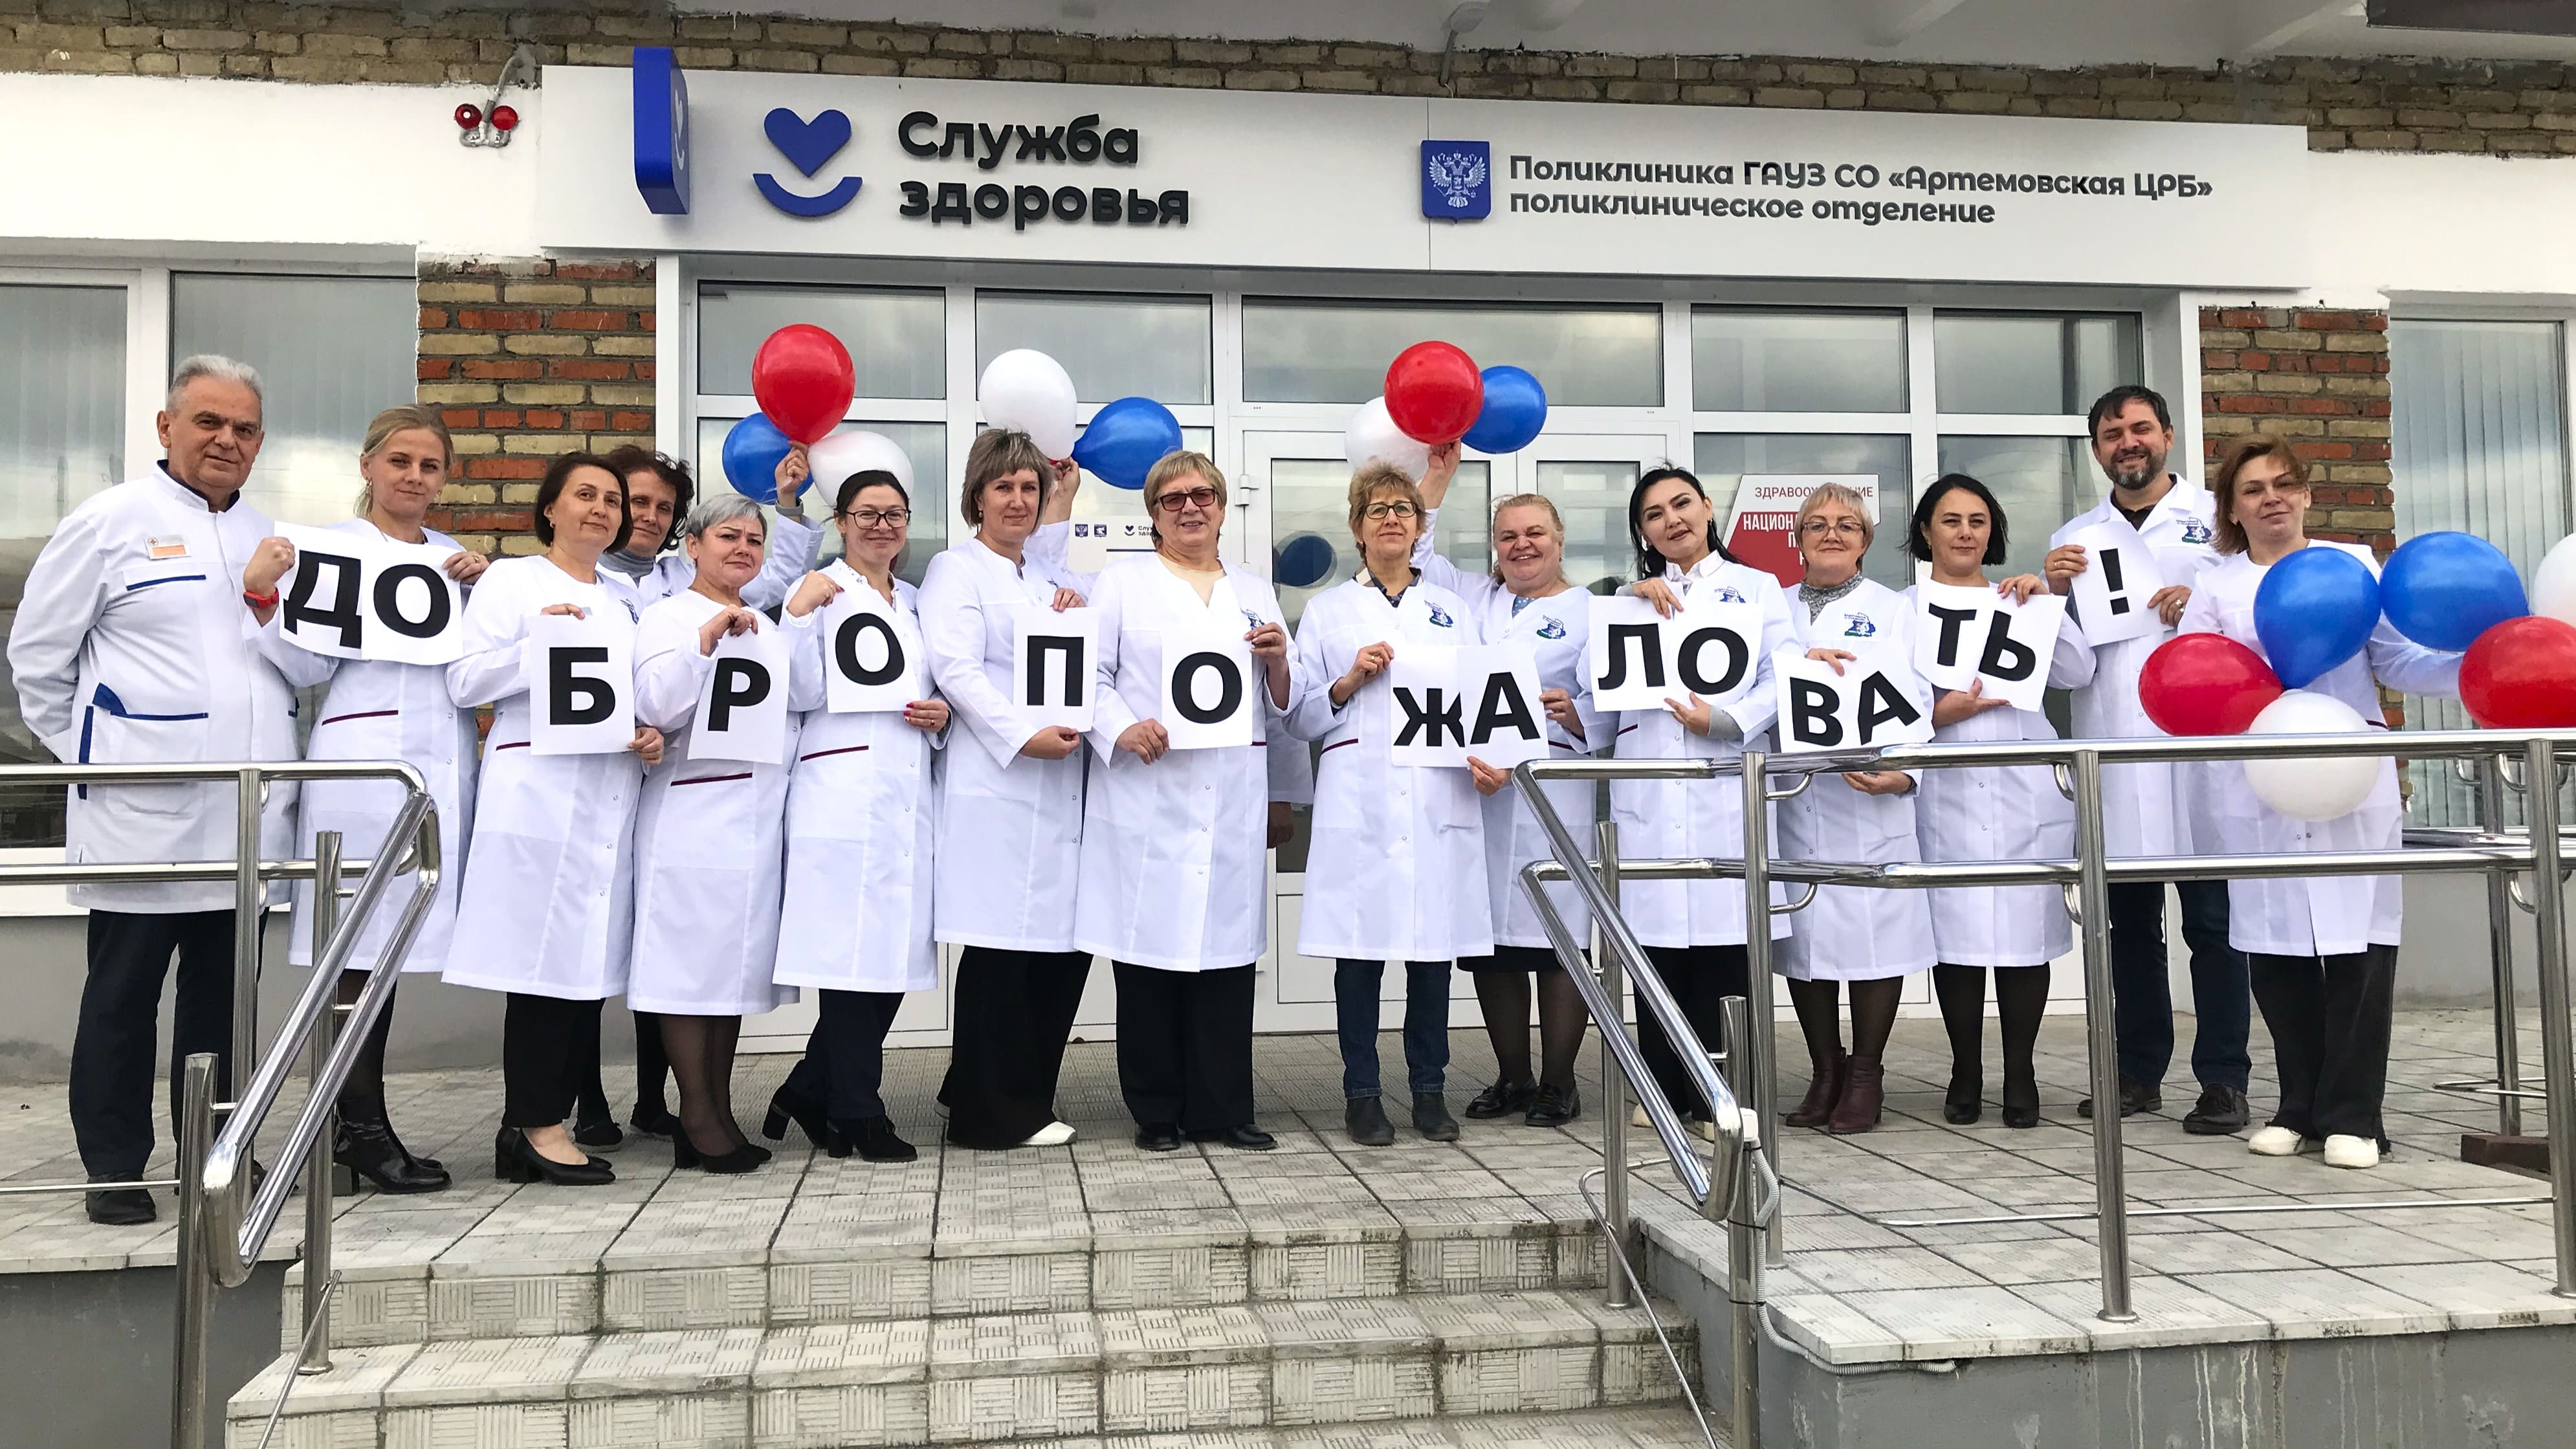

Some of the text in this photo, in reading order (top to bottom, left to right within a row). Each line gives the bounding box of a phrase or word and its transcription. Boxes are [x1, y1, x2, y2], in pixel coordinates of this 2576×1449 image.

[897, 110, 1139, 170] Служба
[1510, 154, 2214, 201] Поликлиника ГАУЗ СО «Артемовская ЦРБ»
[899, 180, 1189, 232] здоровья
[1510, 192, 1996, 226] поликлиническое отделение
